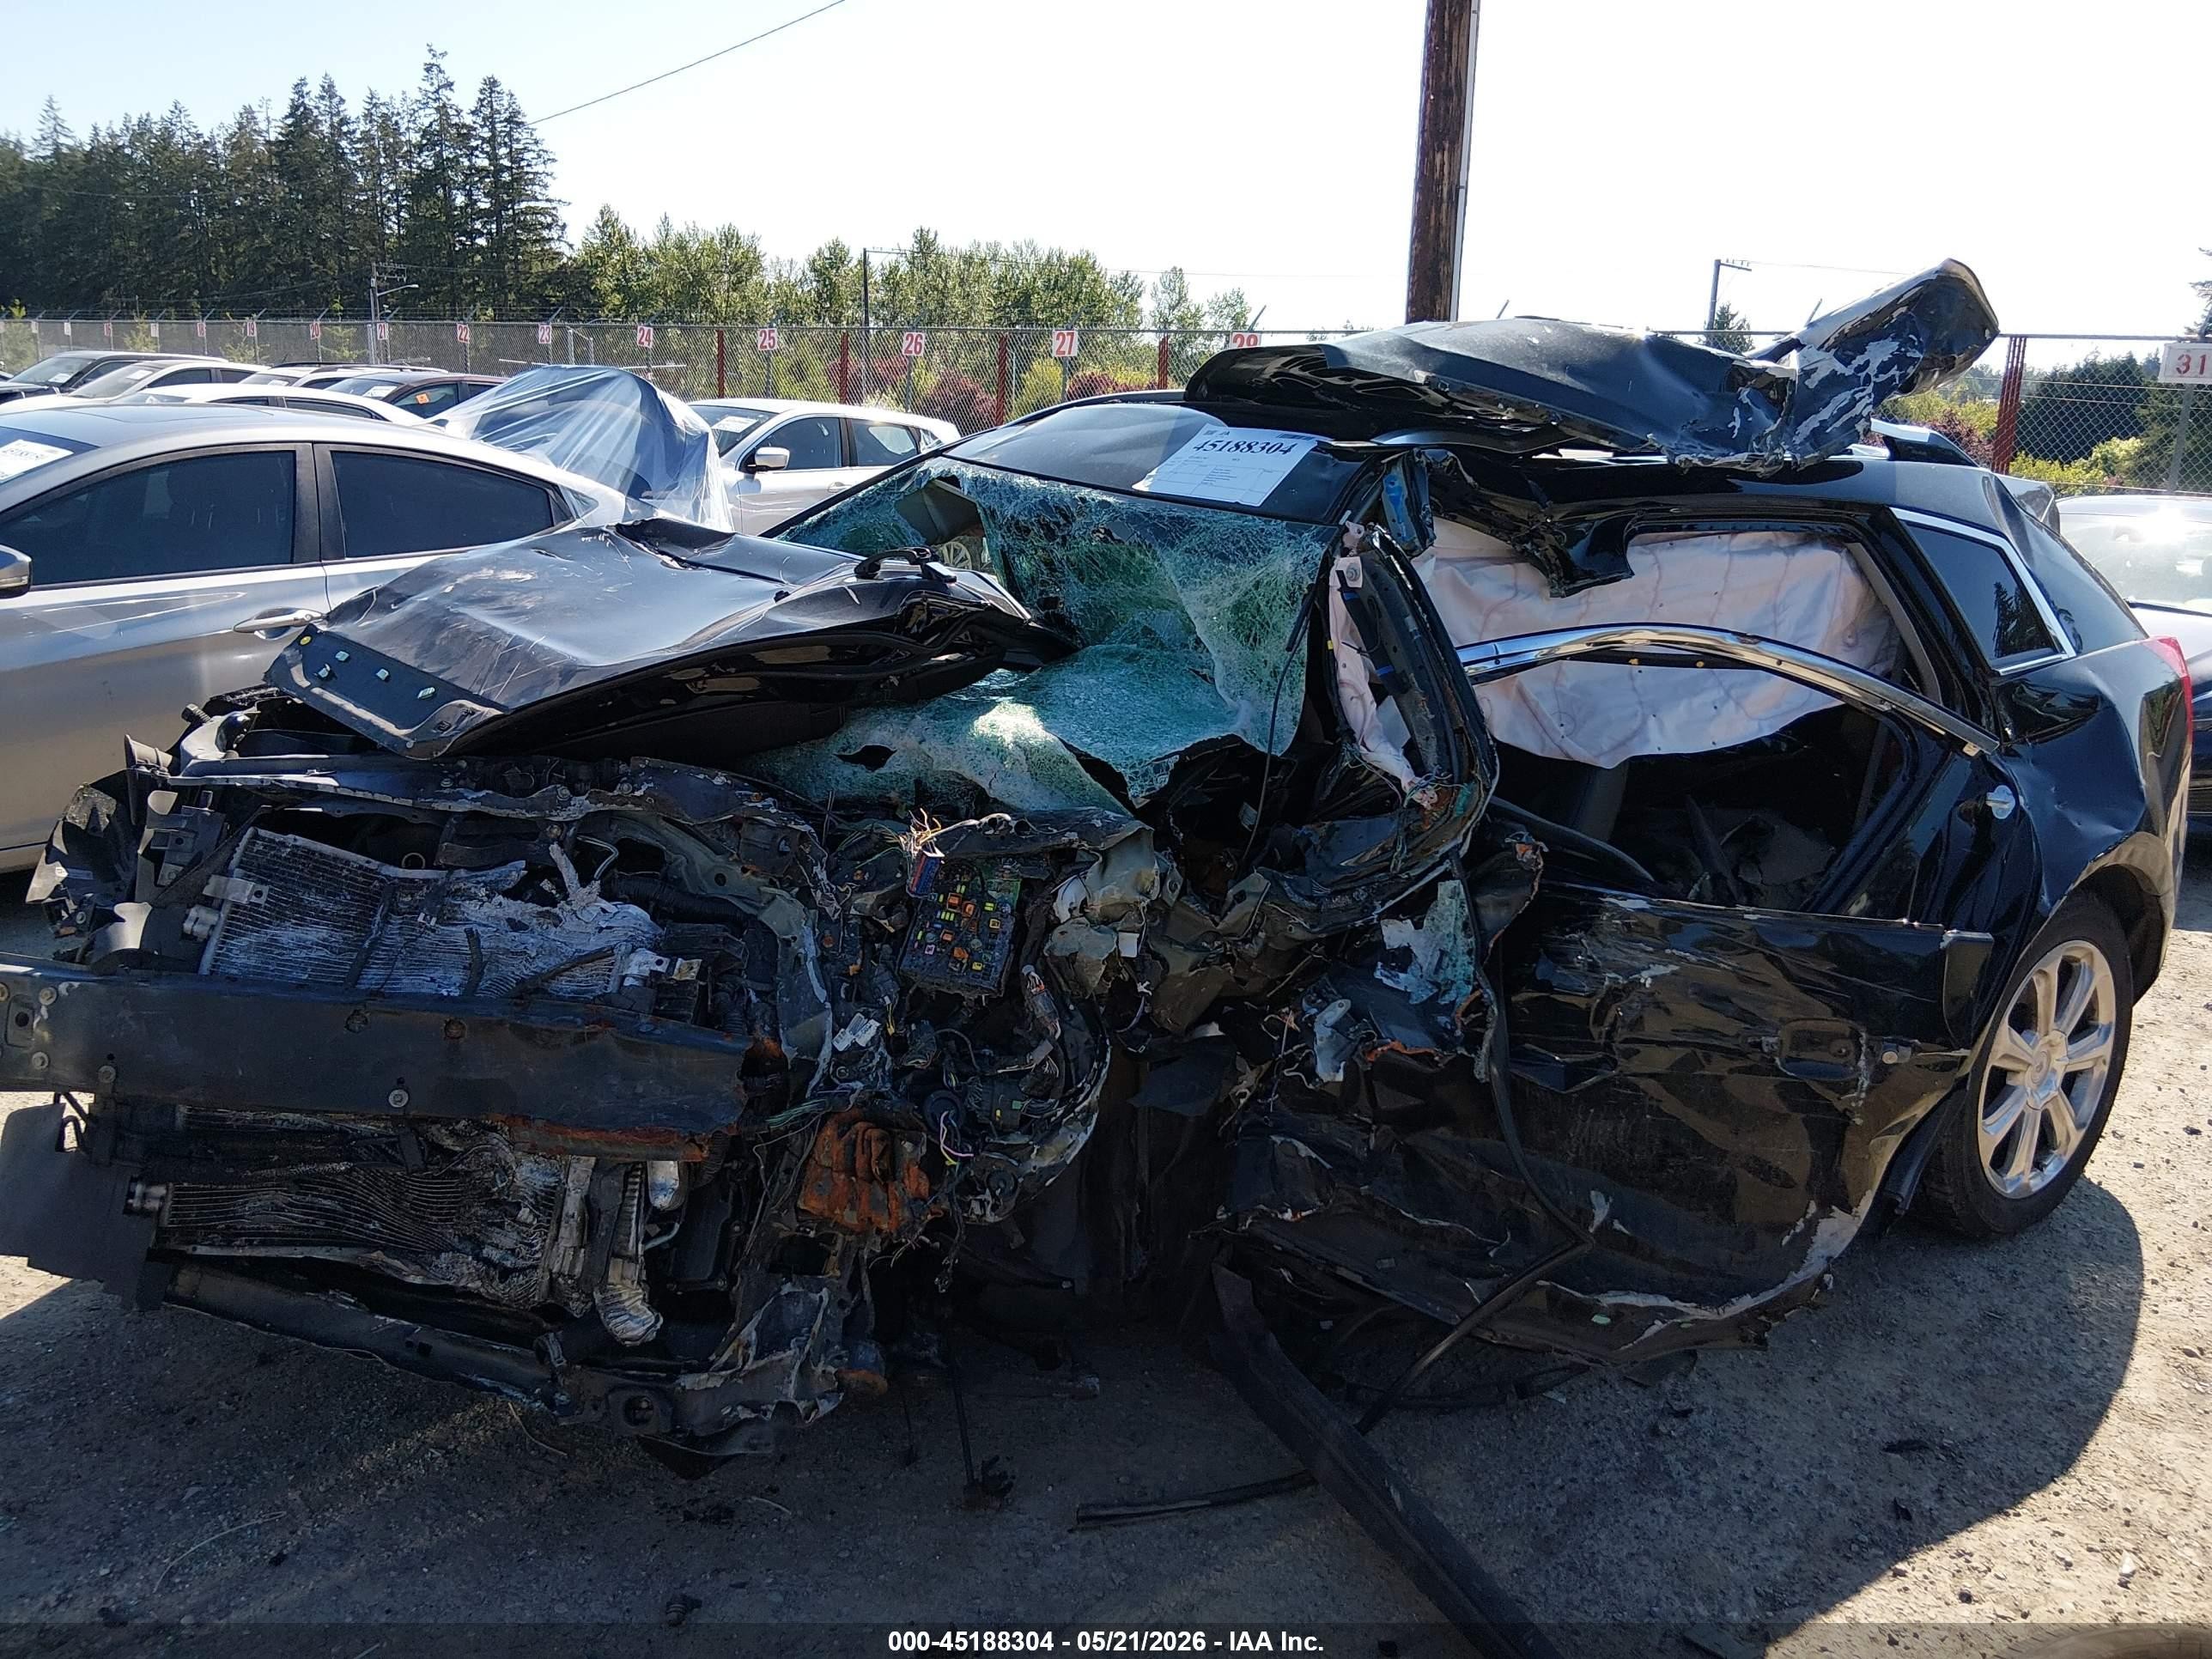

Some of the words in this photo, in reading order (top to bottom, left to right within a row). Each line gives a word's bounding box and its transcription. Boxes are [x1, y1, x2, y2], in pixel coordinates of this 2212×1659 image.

[311, 323, 319, 337] 20
[378, 324, 386, 339] 21
[458, 325, 469, 342] 22
[539, 325, 550, 343] 23
[638, 327, 652, 347] 24
[759, 329, 776, 349] 25
[904, 333, 923, 356] 26
[1056, 332, 1074, 356] 27
[2175, 353, 2207, 376] 31
[1193, 439, 1298, 455] 45188304
